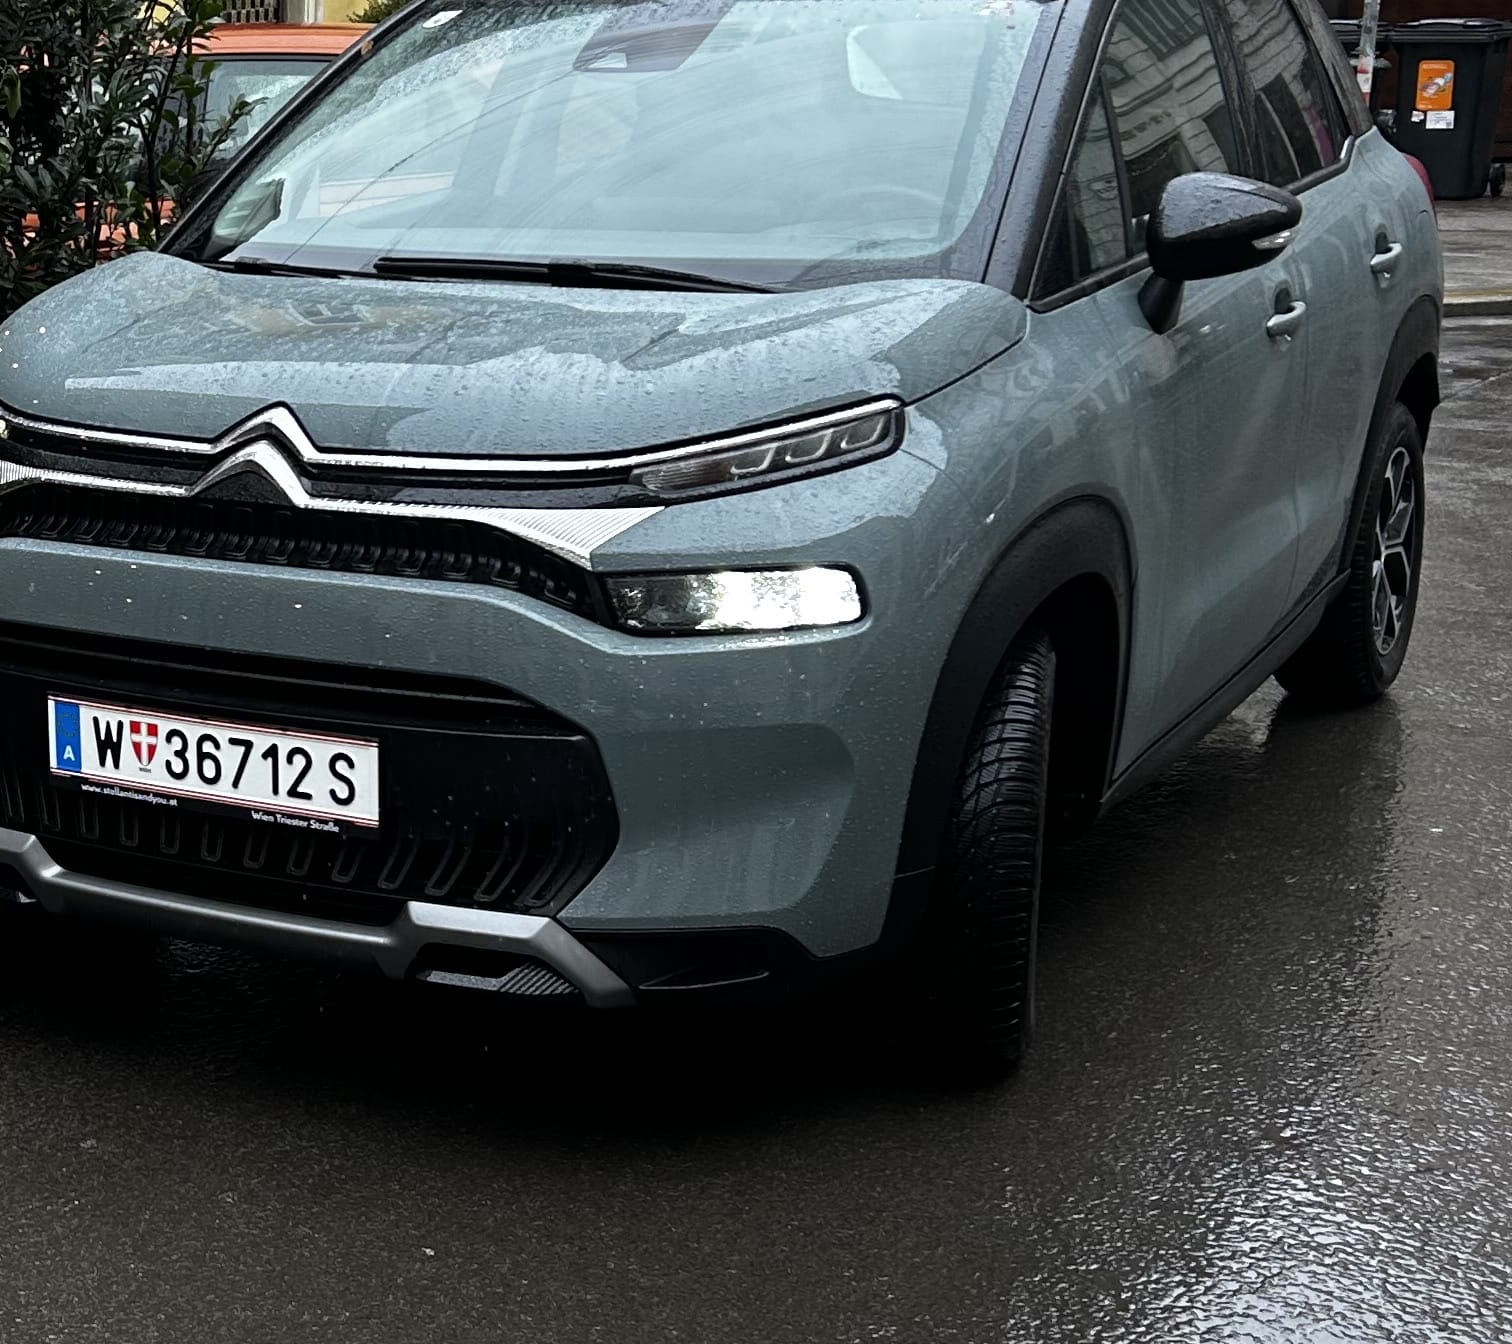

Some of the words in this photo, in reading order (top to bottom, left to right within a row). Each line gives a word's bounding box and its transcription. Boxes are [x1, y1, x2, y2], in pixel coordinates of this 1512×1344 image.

[63, 744, 76, 762] A
[92, 716, 124, 770] W
[165, 729, 313, 801] 36712
[328, 752, 356, 806] S
[251, 810, 275, 822] Wien
